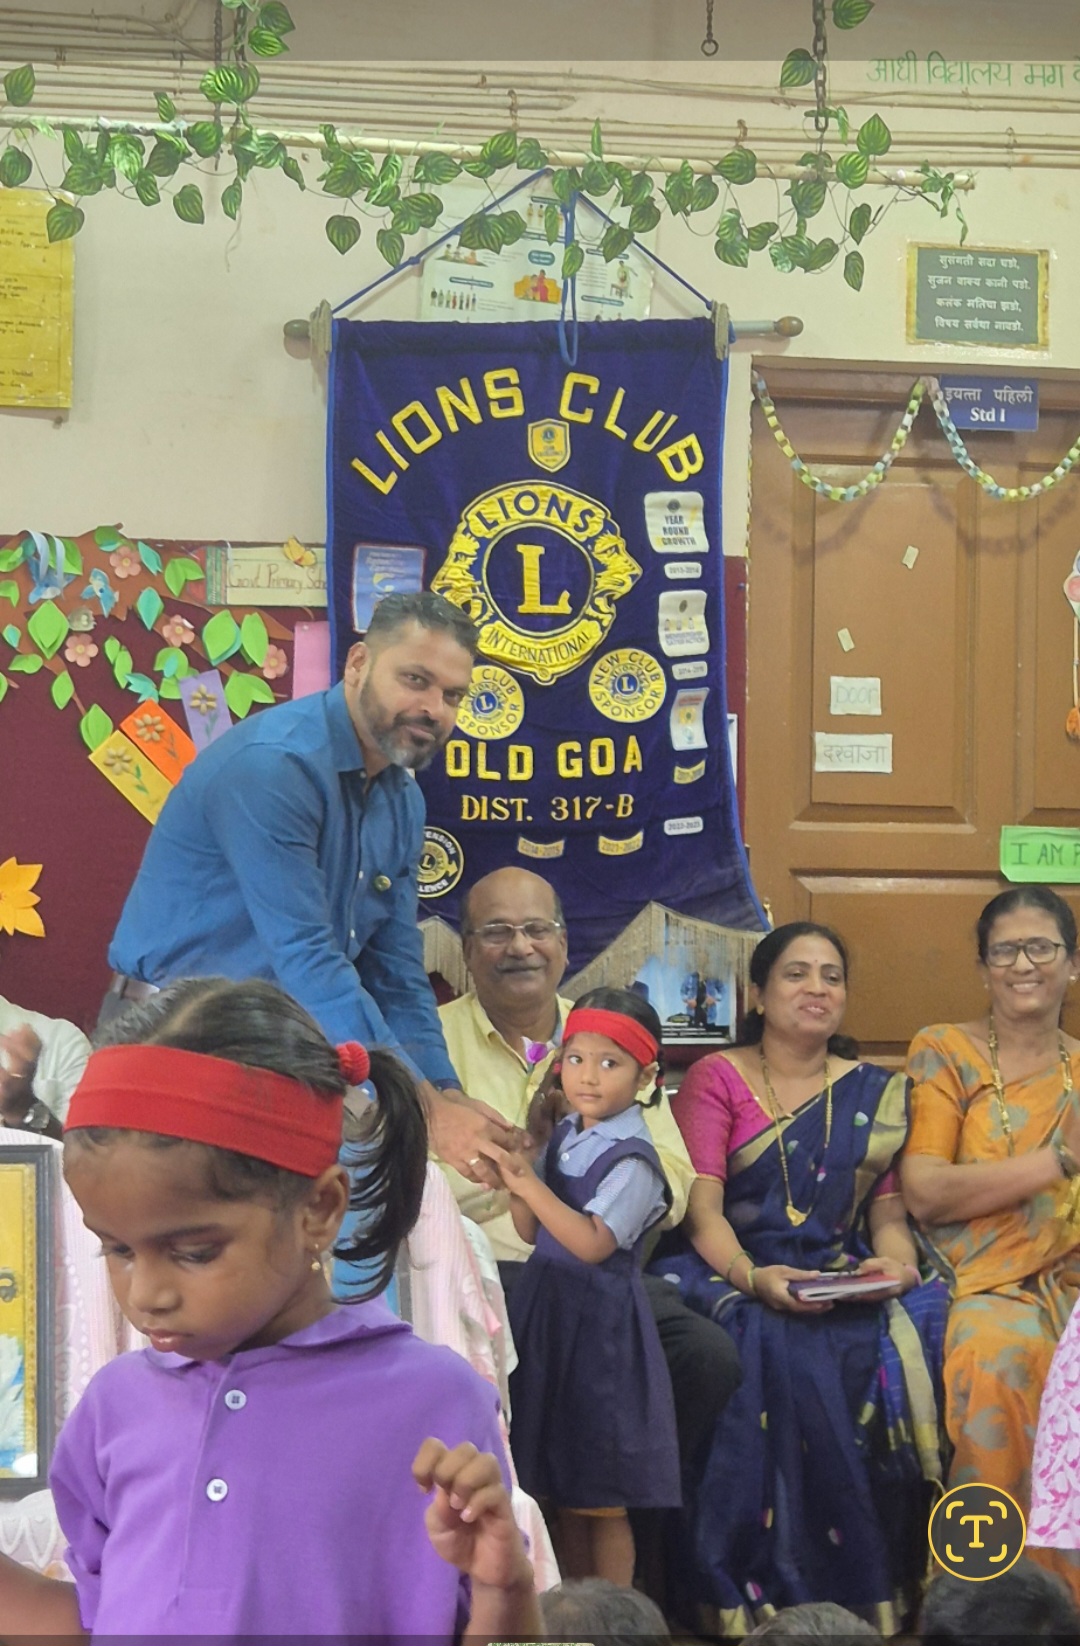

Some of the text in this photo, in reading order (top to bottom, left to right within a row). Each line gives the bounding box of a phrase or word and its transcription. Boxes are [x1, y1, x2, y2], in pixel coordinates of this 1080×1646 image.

[866, 50, 917, 84] आधी
[926, 50, 1014, 88] विद्यालय
[1024, 62, 1066, 88] मग
[944, 385, 1034, 404] इयत्ता पहिली
[970, 407, 995, 422] Std
[351, 367, 705, 495] LIONS CLUB
[475, 489, 596, 534] LIONS
[664, 515, 685, 525] YEAR
[660, 537, 697, 546] GROWTH
[662, 526, 690, 535] ROUND
[517, 543, 573, 615] L
[485, 626, 591, 665] INTERNATIONAL
[482, 668, 517, 695] CLUB
[593, 651, 662, 686] NEW CLUB
[595, 689, 661, 718] SPONSOR
[458, 703, 521, 736] SPONSOR
[446, 735, 643, 781] OLD GOA
[823, 744, 889, 764] दरवाजा
[460, 793, 635, 822] DIST. 317-B
[424, 831, 457, 855] ENSION
[1010, 842, 1029, 866] I
[1037, 842, 1065, 866] AM
